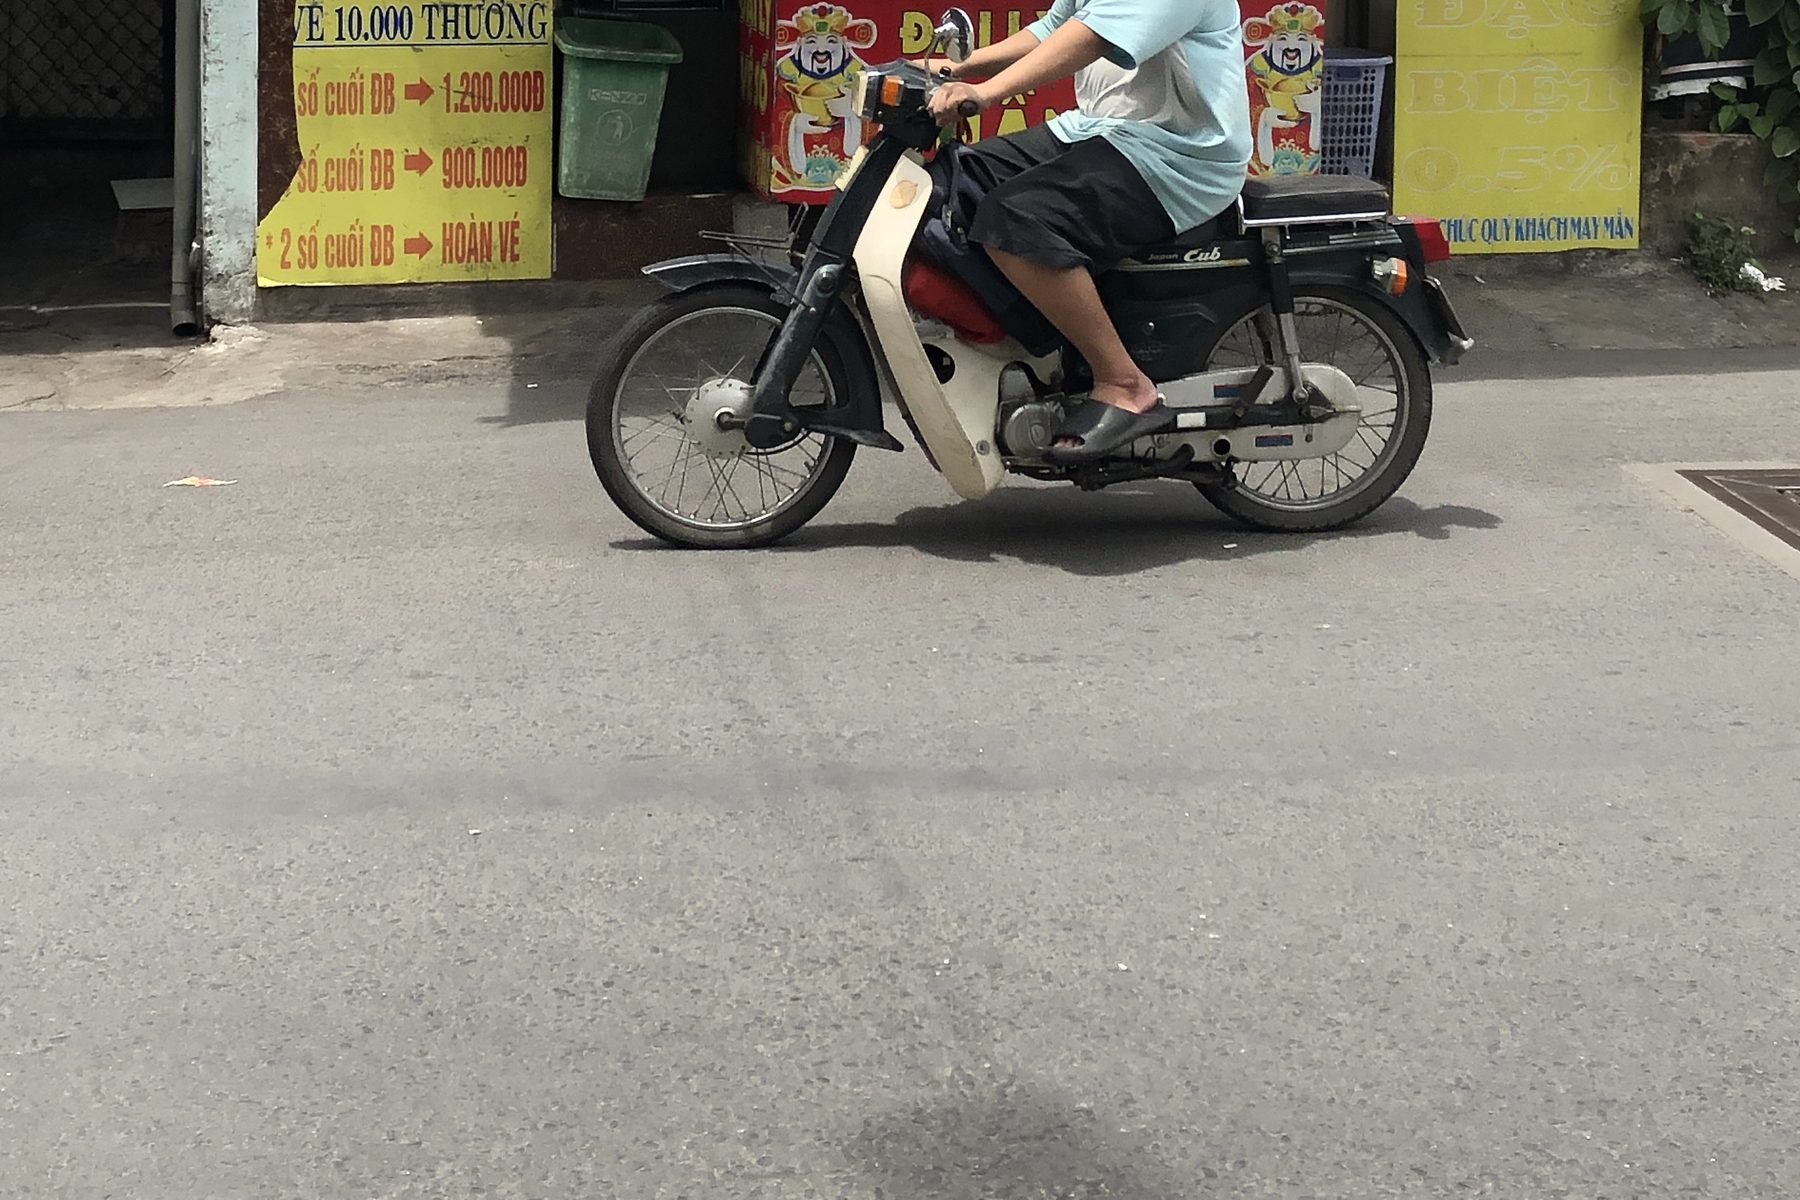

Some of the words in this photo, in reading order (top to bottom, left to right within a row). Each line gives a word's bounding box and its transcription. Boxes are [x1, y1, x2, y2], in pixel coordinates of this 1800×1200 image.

[335, 5, 413, 41] 10.000
[900, 10, 991, 54] ĐI
[280, 228, 291, 269] 2
[442, 212, 493, 264] HOÀN
[498, 211, 521, 263] VÉ
[1515, 212, 1568, 242] KHÁCH
[1571, 216, 1600, 240] MAY
[1183, 246, 1221, 262] Cub
